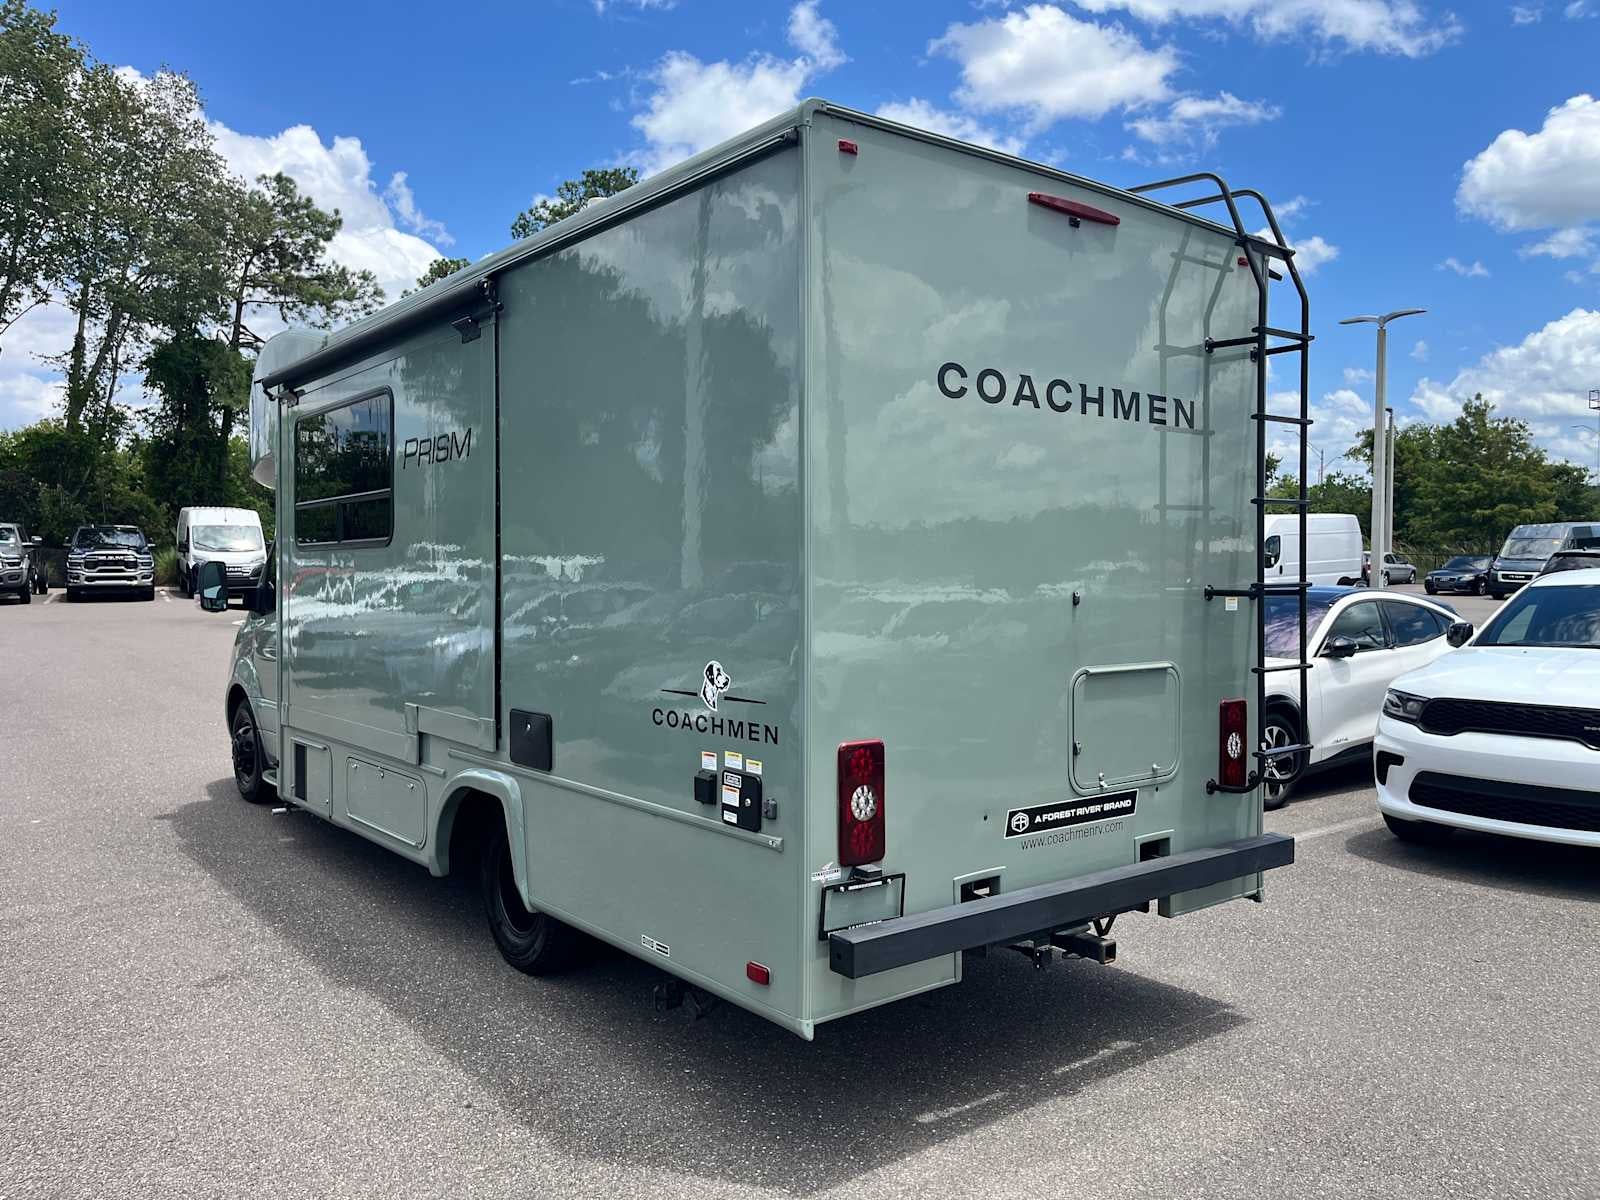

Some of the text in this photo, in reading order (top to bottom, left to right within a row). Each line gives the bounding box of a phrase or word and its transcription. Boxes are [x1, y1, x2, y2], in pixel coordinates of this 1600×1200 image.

[937, 362, 1195, 429] COACHMEN
[402, 427, 472, 470] PRISM
[652, 708, 779, 745] COACHMEN
[1034, 815, 1042, 824] A
[1042, 808, 1076, 822] FOREST
[1103, 799, 1132, 811] BRAND
[1020, 821, 1124, 850] www.coachmenrv.com
